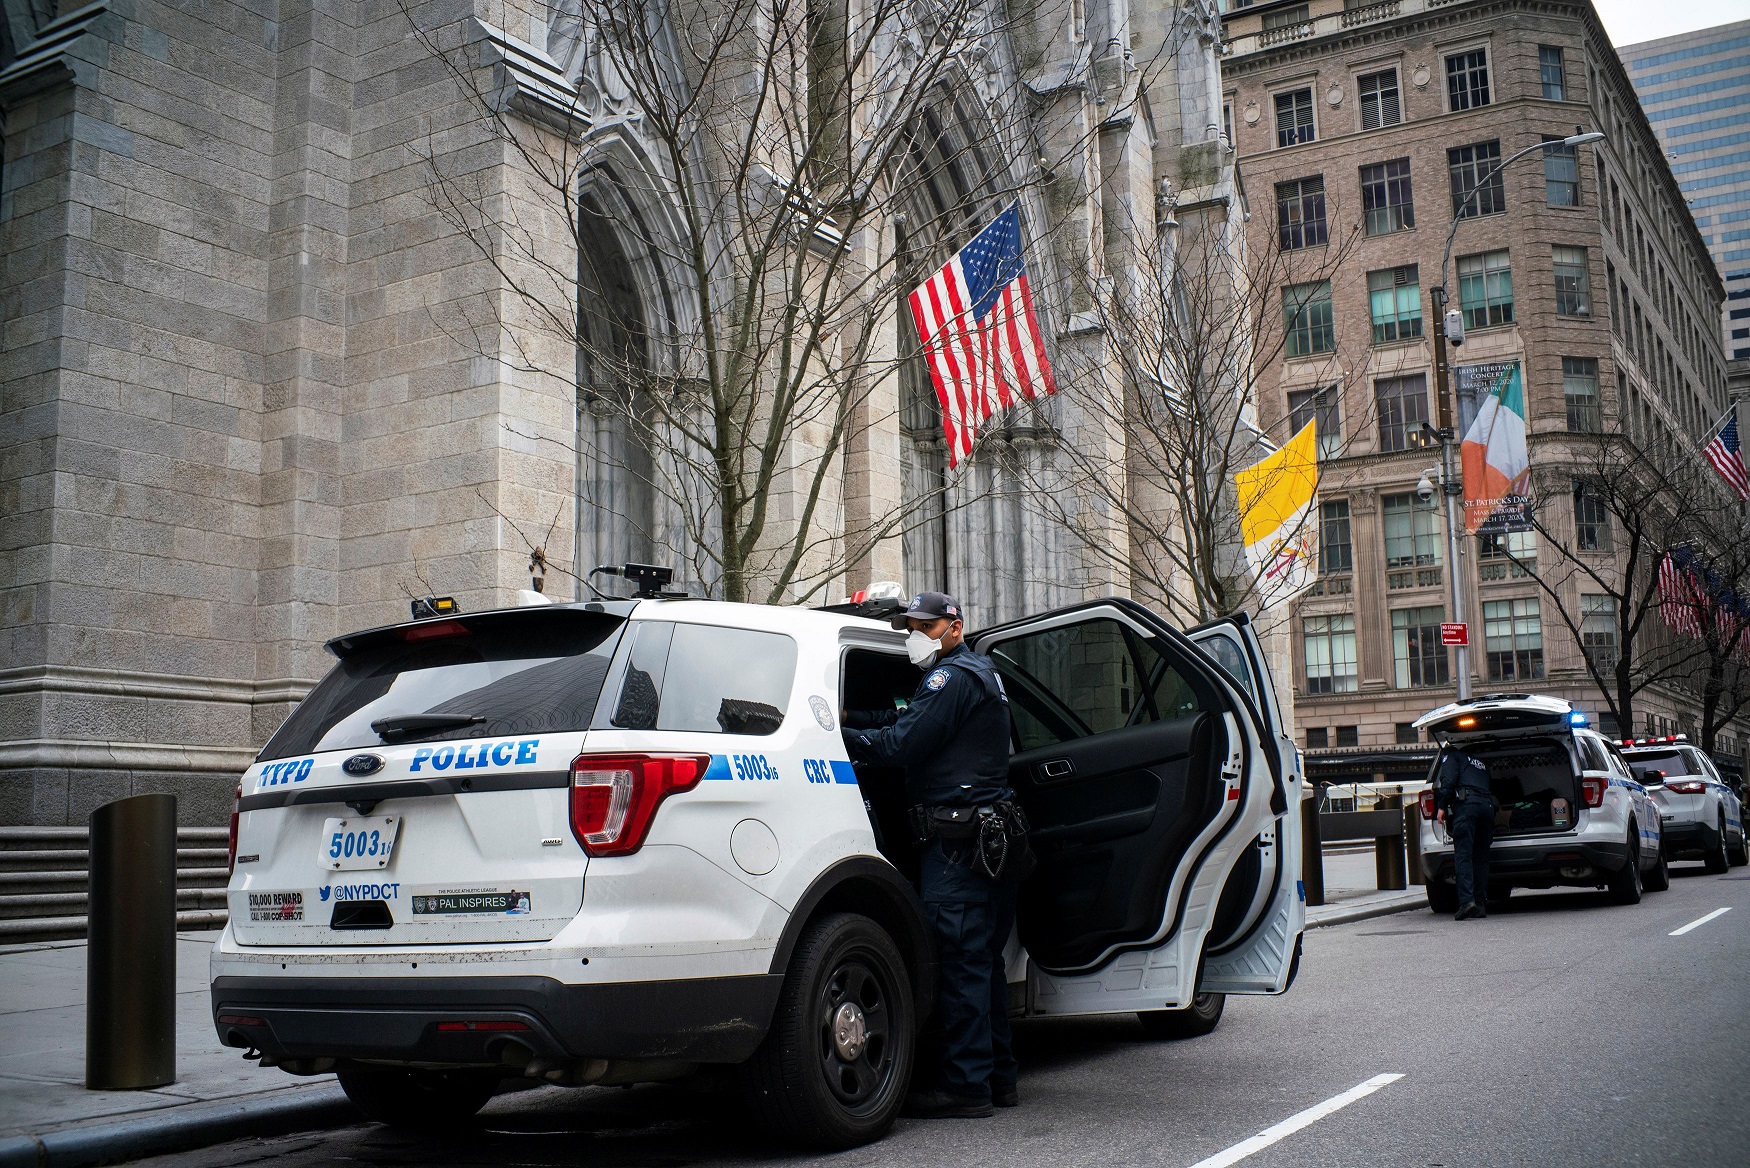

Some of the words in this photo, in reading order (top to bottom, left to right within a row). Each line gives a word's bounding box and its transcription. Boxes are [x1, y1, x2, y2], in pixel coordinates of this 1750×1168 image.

[1470, 371, 1503, 379] CONCERT
[1480, 364, 1515, 372] HERITAGE
[1462, 381, 1487, 389] MARCH
[1464, 500, 1475, 508] ST.
[1476, 497, 1512, 506] PATRICK'S
[1513, 495, 1529, 504] DAY
[1473, 516, 1497, 524] MARCH
[409, 739, 540, 772] POLICE
[348, 756, 372, 771] Ford
[732, 754, 771, 781] 5003
[803, 758, 831, 784] CRC
[256, 758, 315, 787] NYPD
[329, 829, 380, 858] 5003
[249, 892, 272, 907] $10,000
[273, 892, 303, 906] REWARD
[334, 883, 400, 901] @NYPDCT
[439, 898, 457, 909] PAL
[459, 897, 507, 908] INSPIRES
[251, 912, 260, 921] CALL
